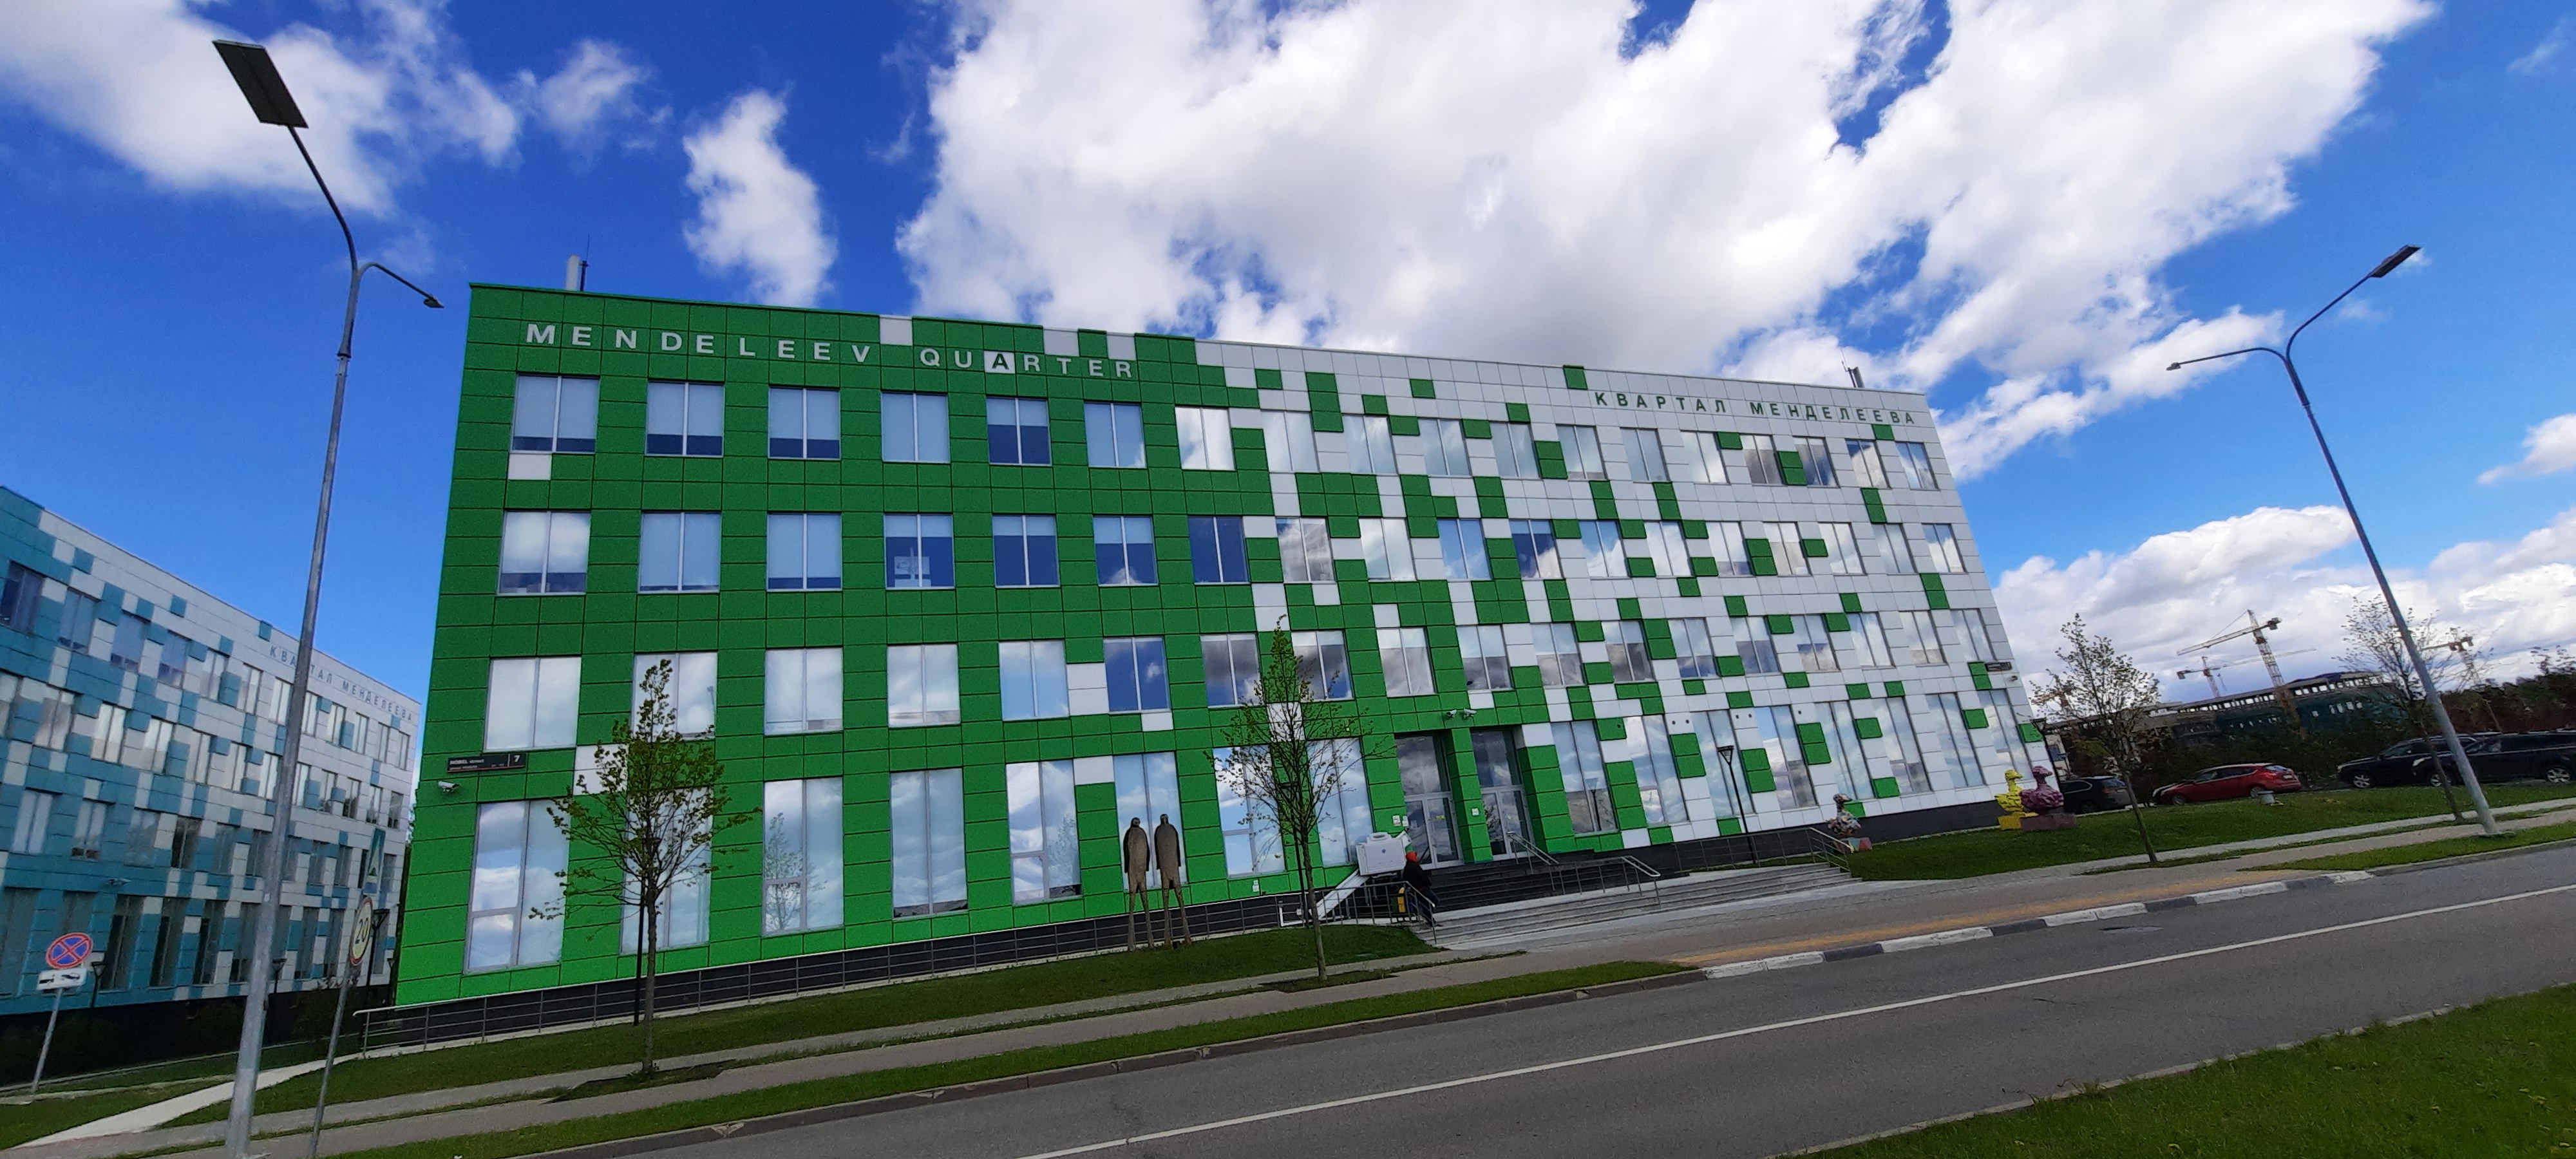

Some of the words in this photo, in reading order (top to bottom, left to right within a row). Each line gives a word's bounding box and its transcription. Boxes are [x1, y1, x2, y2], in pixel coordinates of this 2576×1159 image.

[526, 323, 870, 363] MENDELEEV
[920, 348, 1132, 379] QUARTER
[1594, 391, 1727, 413] КВАРТАЛ
[1748, 401, 1915, 426] МЕНДЕЛЕЕВА
[270, 645, 333, 684] КВАТАЛ
[341, 680, 412, 721] МЕНДЕЛЕЕВА
[355, 917, 369, 945] 20
